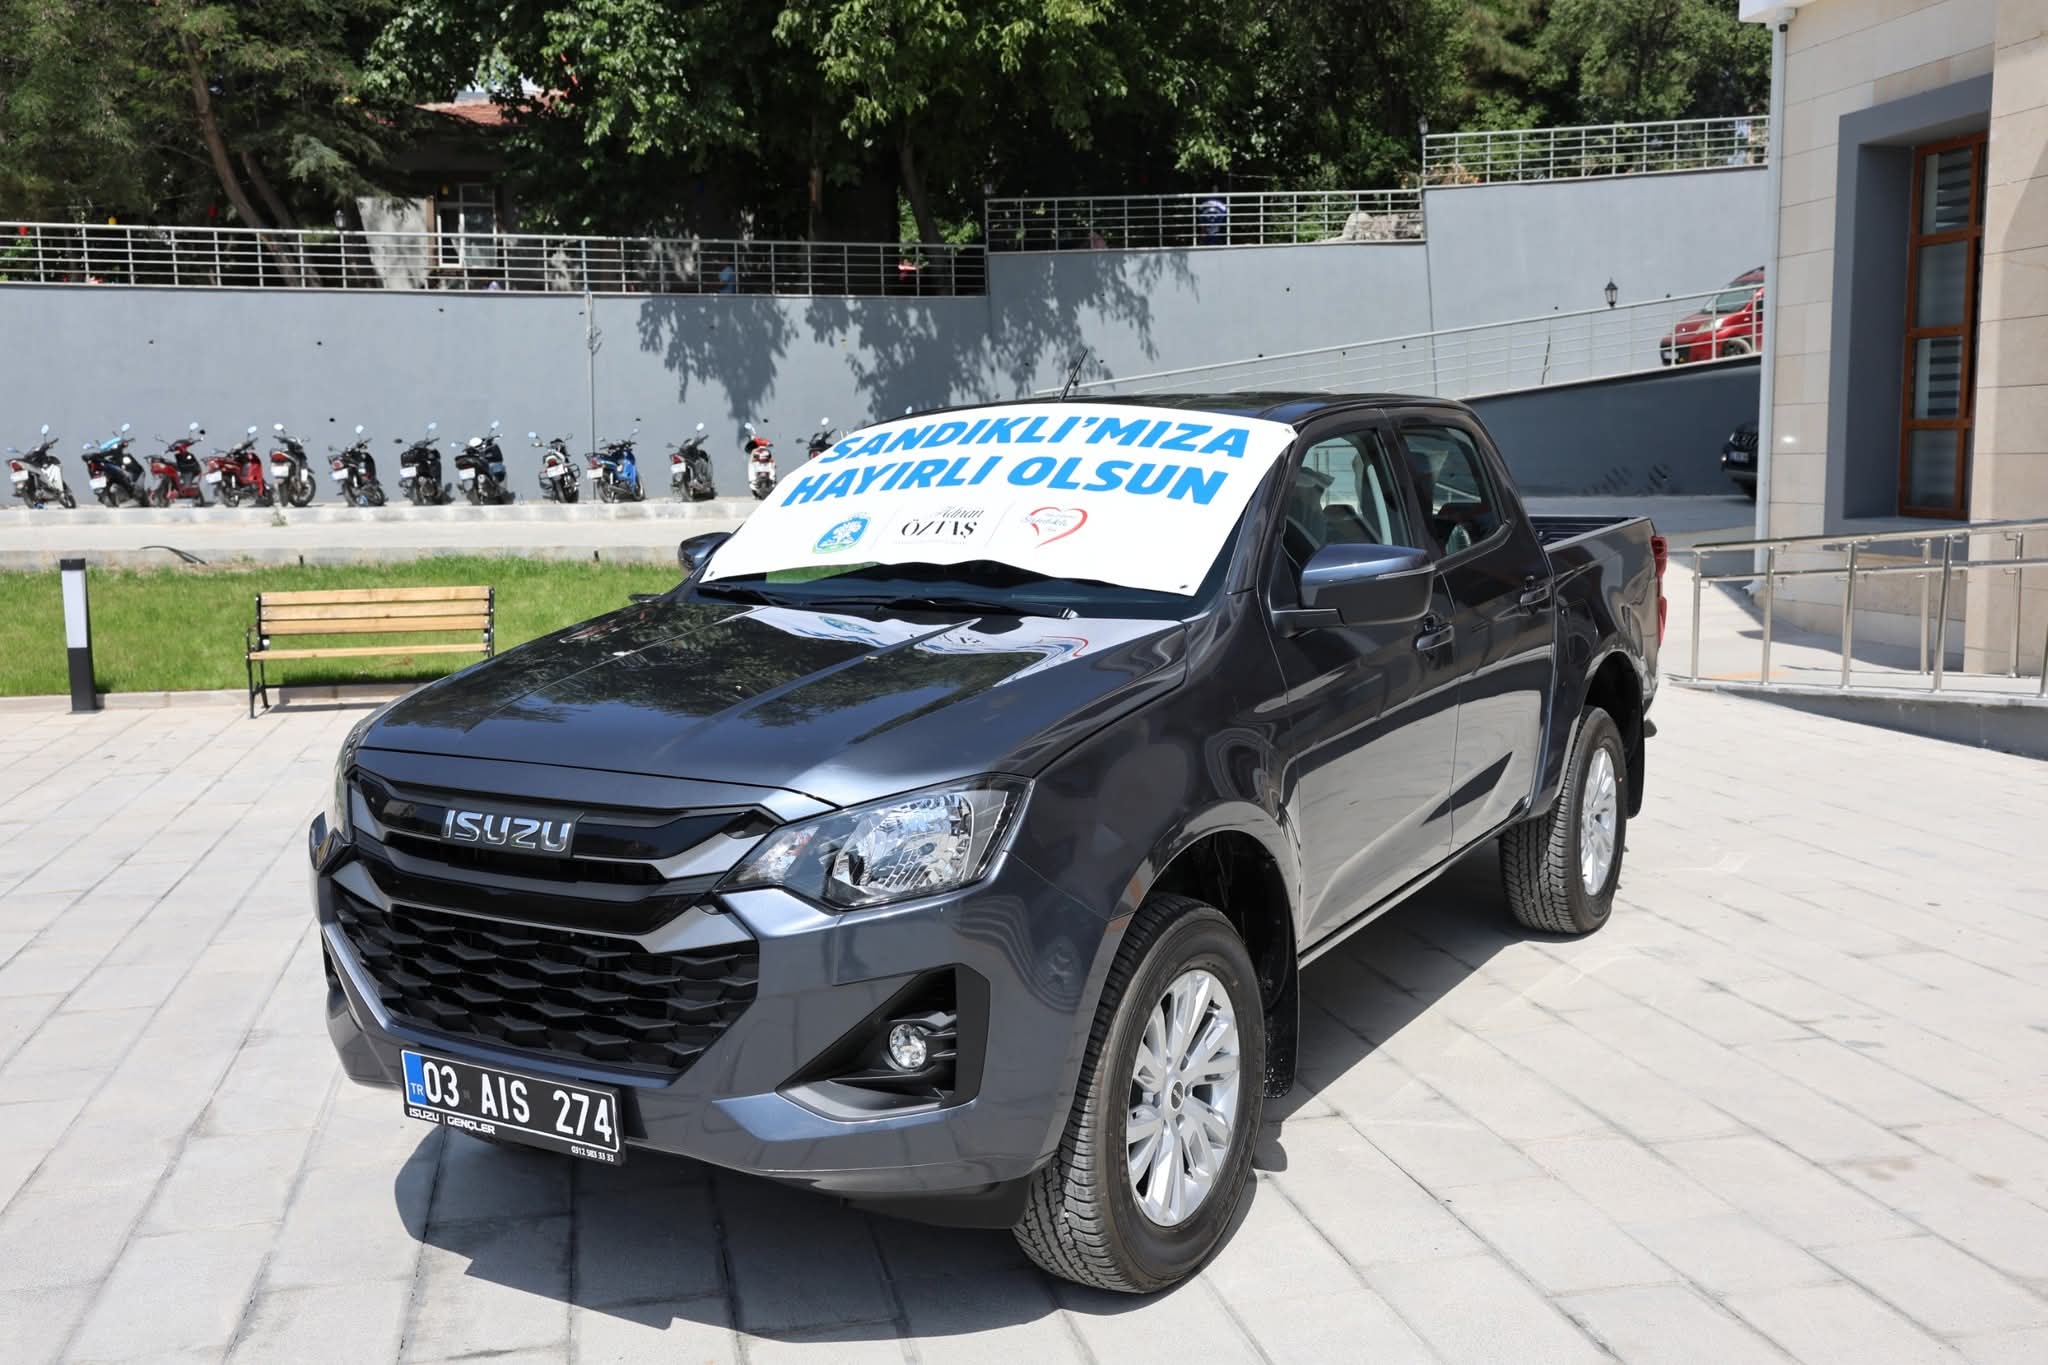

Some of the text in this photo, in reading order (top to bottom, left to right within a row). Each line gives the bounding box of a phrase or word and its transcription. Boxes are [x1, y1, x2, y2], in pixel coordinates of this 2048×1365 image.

[781, 455, 1228, 507] HAYIRLI OLSUN
[442, 810, 572, 852] ISUZU
[410, 1082, 424, 1096] TR
[422, 1061, 612, 1142] 03 AIS 274
[409, 1107, 496, 1135] ISUZU GENÇLER
